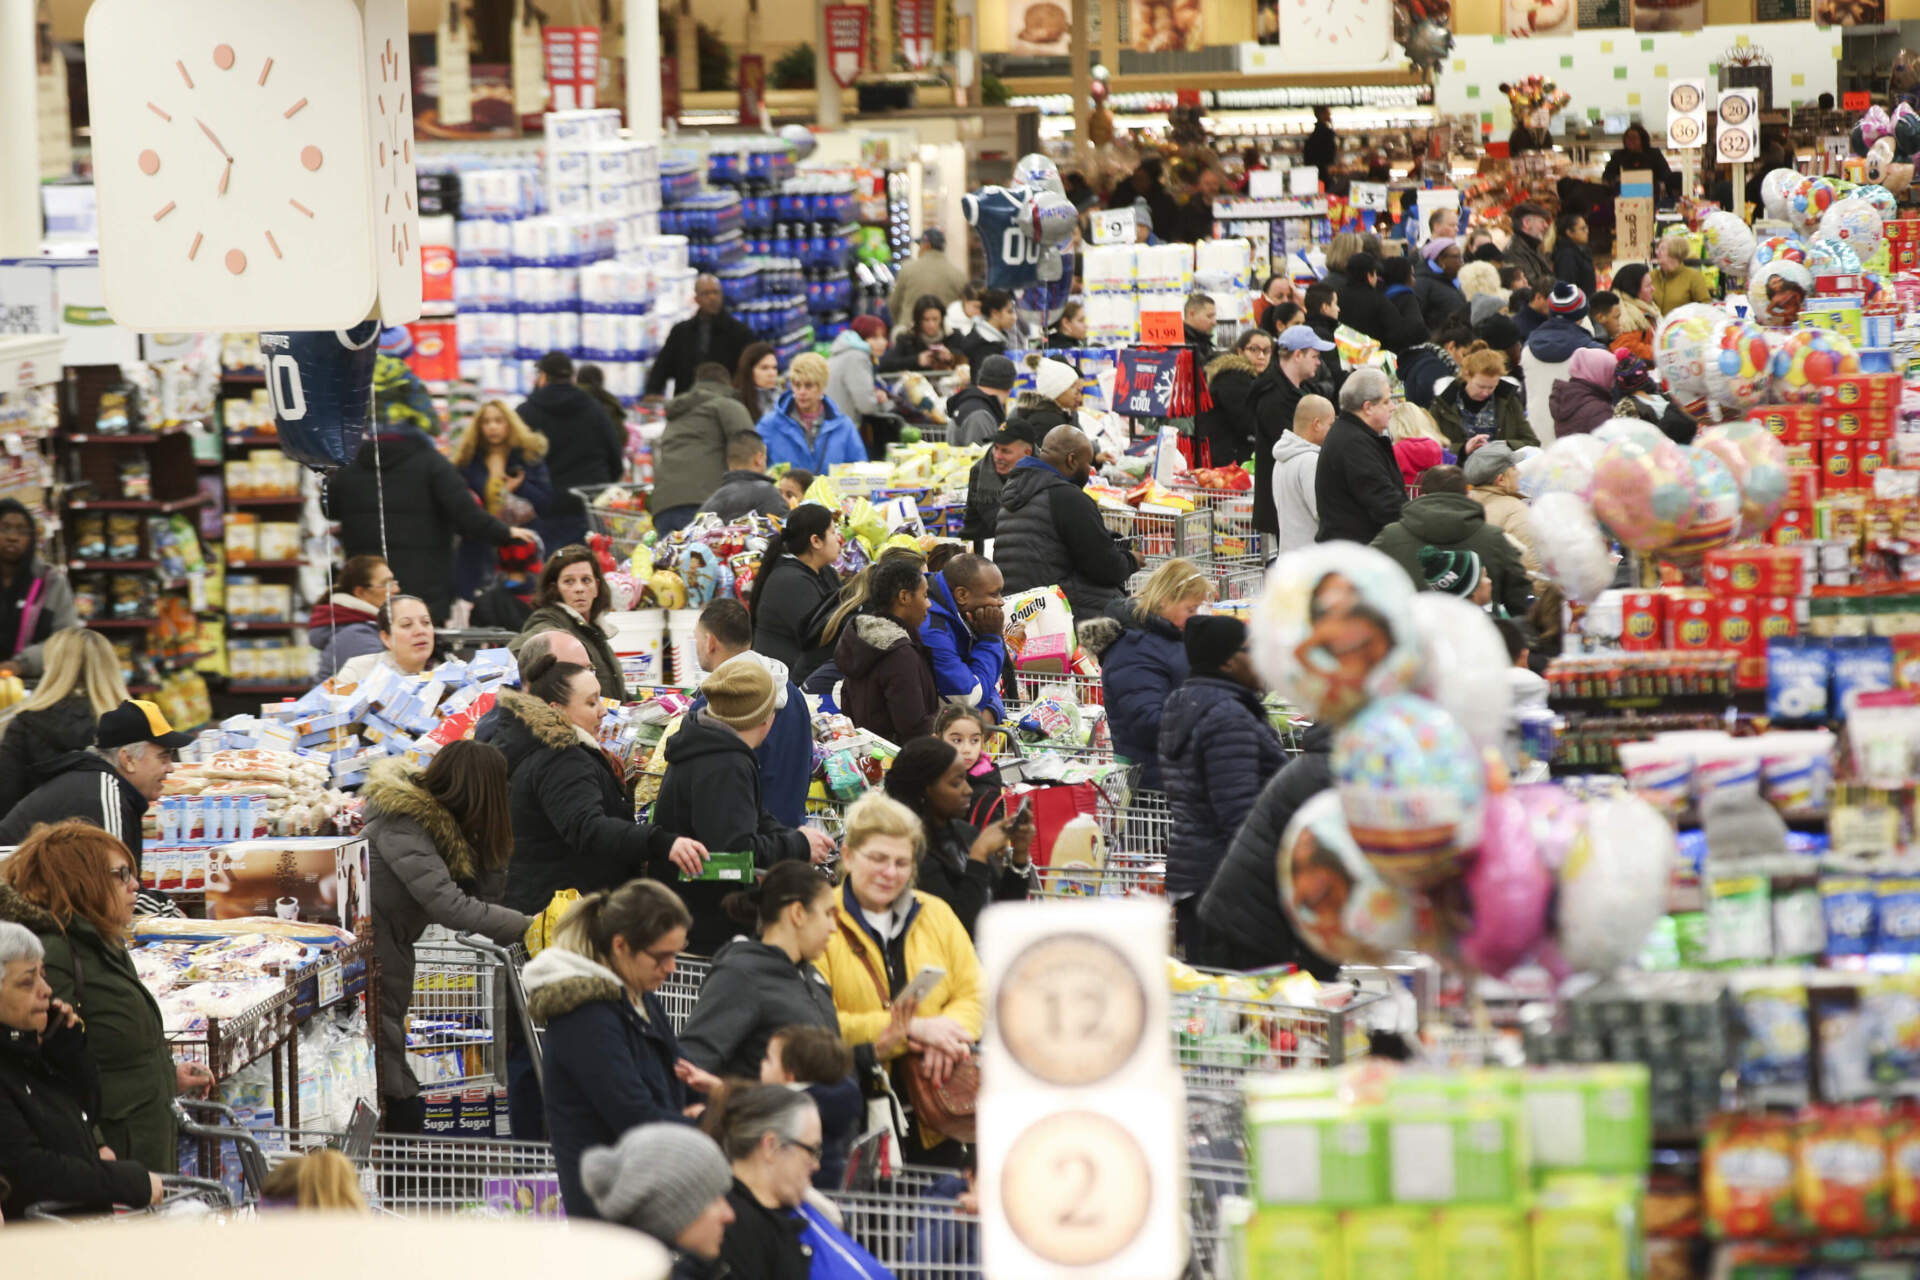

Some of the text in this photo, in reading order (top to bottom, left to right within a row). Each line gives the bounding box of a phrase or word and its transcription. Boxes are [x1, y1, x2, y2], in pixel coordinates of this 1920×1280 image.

[1678, 91, 1692, 105] 12
[1727, 103, 1745, 117] 20
[1676, 123, 1695, 138] 36
[1723, 136, 1746, 152] 32
[1147, 327, 1177, 340] $1.99
[1134, 372, 1156, 391] HOT
[1130, 395, 1151, 413] COOL
[1010, 596, 1046, 624] Bounty
[1041, 988, 1109, 1041] 12
[423, 1118, 455, 1132] Sugar
[459, 1117, 491, 1131] Sugar
[1050, 1148, 1106, 1229] 2
